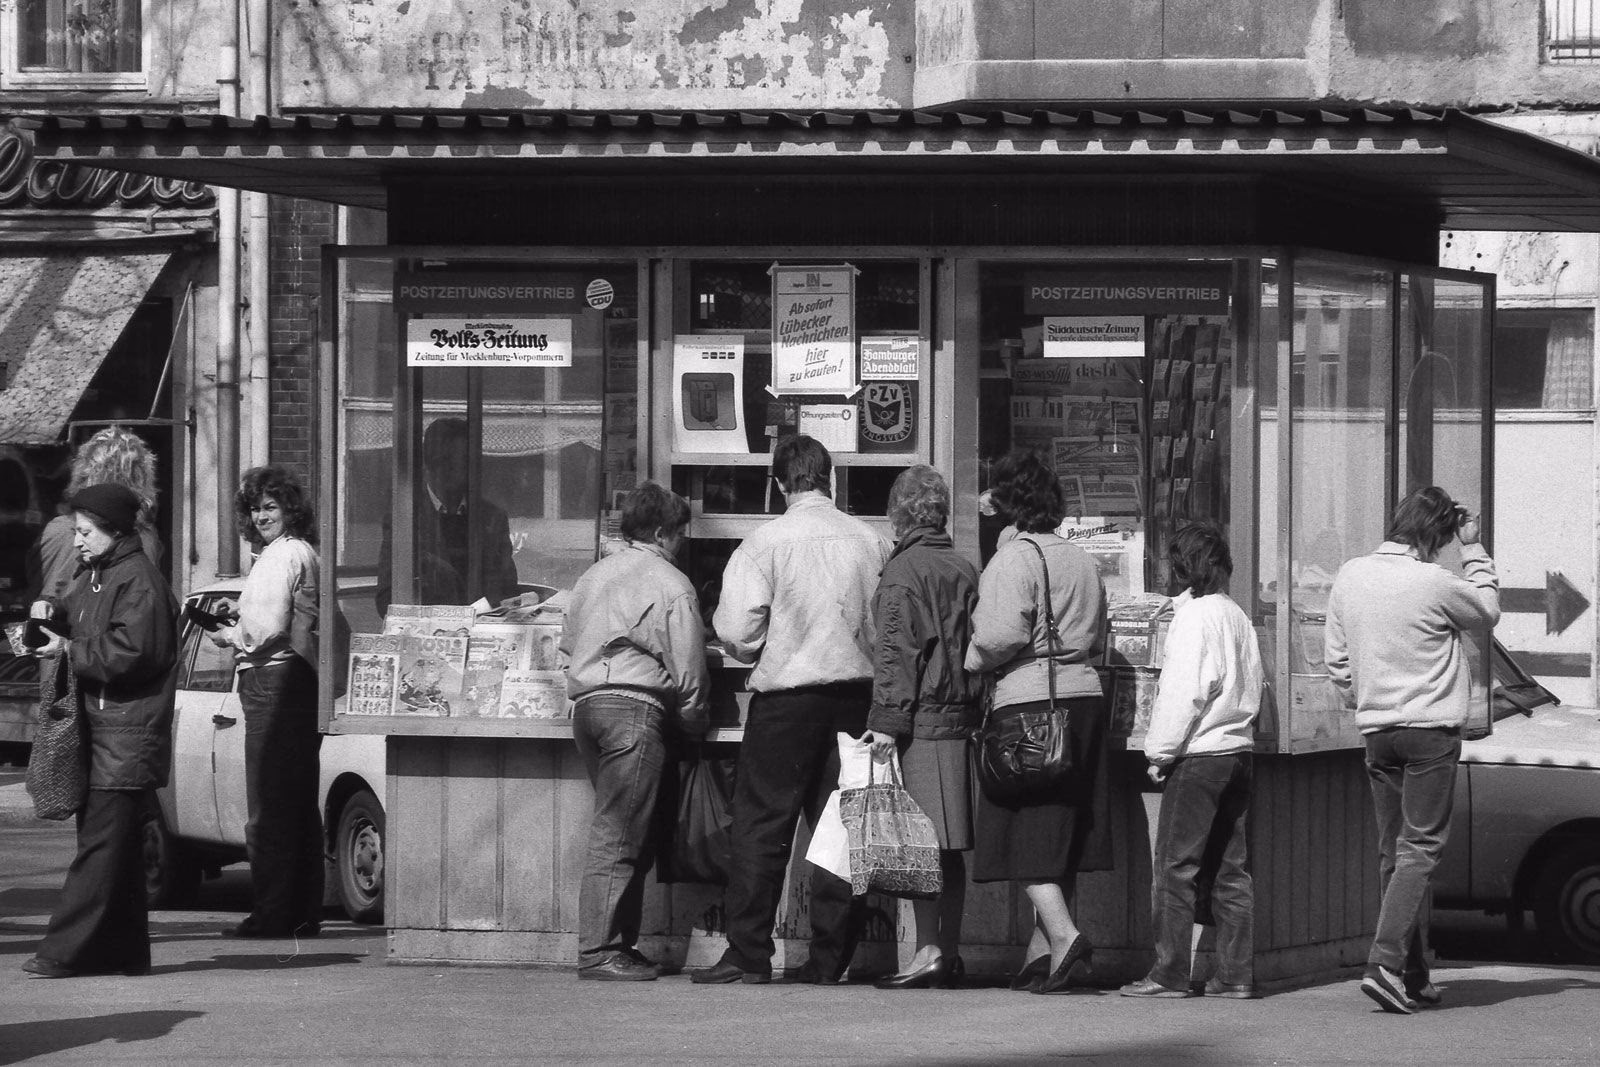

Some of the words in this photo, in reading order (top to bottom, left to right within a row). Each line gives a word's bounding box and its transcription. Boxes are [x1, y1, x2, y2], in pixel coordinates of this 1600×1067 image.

[400, 286, 576, 299] POSTZEITUNGSVERTRIEB
[1031, 287, 1220, 300] POSTZEITUNGSVERTRIEB
[591, 295, 612, 307] CDU
[789, 302, 804, 316] Ab
[804, 296, 834, 313] sofort
[780, 315, 832, 336] Lübecker
[430, 328, 549, 351] Volks-Zeitung
[781, 325, 849, 349] Nachrichten
[415, 352, 445, 363] Zeitung
[447, 352, 458, 361] für
[460, 352, 564, 363] Mecklenburg-Vorpommern
[805, 348, 829, 363] hier
[863, 348, 917, 363] Hamburger
[789, 373, 802, 383] zu
[804, 358, 844, 380] kaufen!
[863, 361, 916, 374] Abendblatt
[869, 385, 898, 402] PZV
